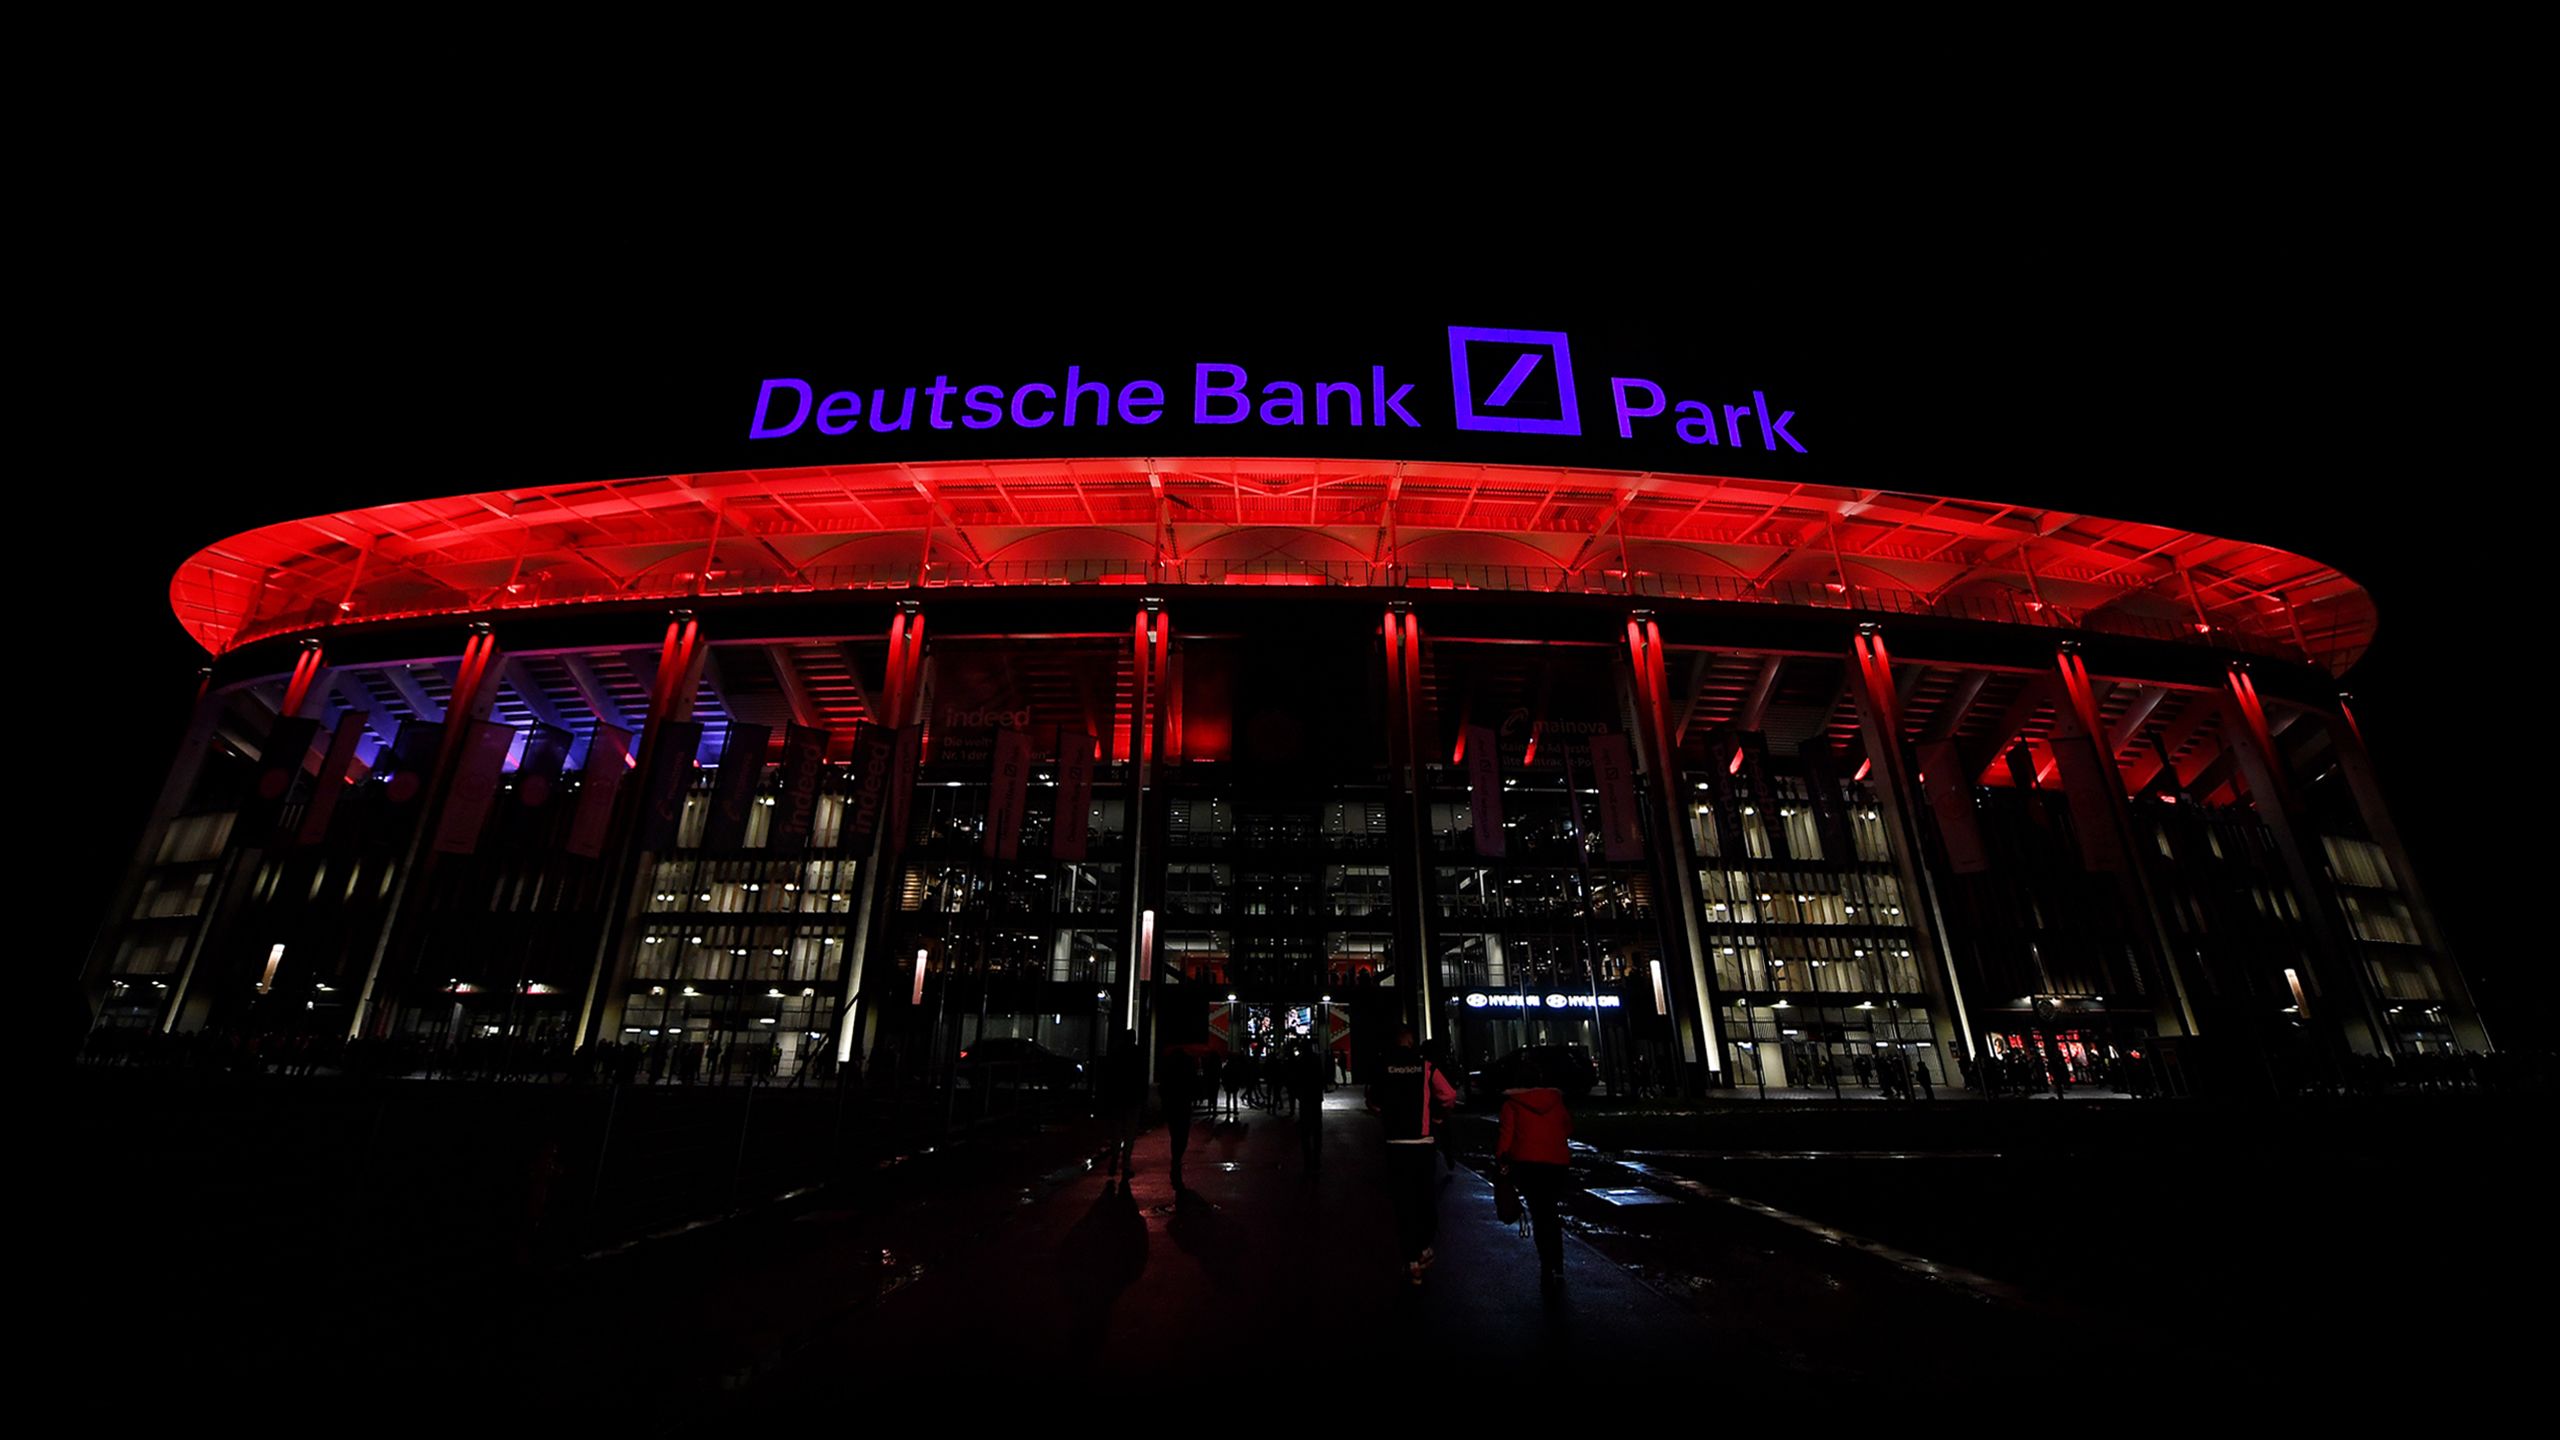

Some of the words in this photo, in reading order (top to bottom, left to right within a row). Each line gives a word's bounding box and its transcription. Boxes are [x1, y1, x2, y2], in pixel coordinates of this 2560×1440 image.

[748, 365, 1165, 440] Deutsche
[1193, 362, 1422, 427] Bank
[1610, 376, 1809, 454] Park
[944, 704, 1031, 728] indeed
